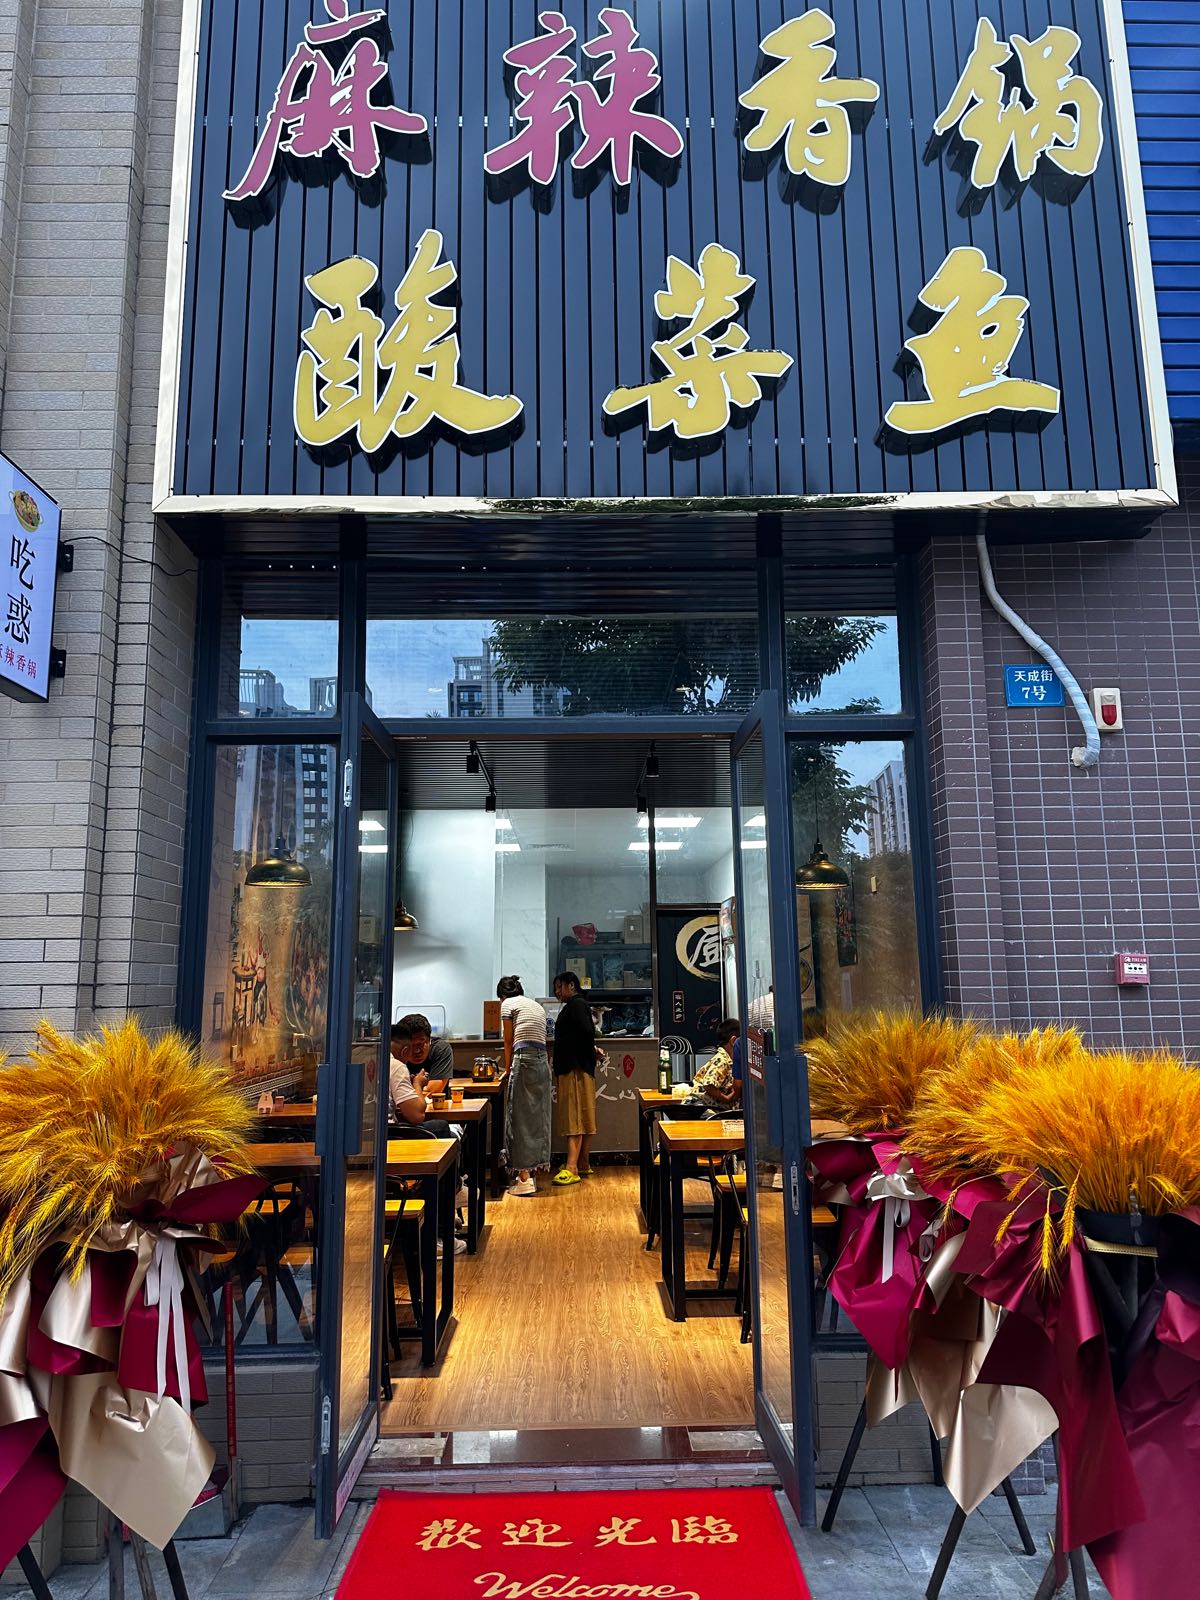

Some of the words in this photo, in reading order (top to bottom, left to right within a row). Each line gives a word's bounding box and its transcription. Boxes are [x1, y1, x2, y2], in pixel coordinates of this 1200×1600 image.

[222, 0, 1105, 200] 麻辣香锅
[294, 228, 1061, 453] 酸菜鱼
[5, 535, 36, 645] 吃惑
[1014, 669, 1053, 682] 天成街
[1021, 685, 1047, 700] 7号
[473, 1571, 700, 1600] Welcome
